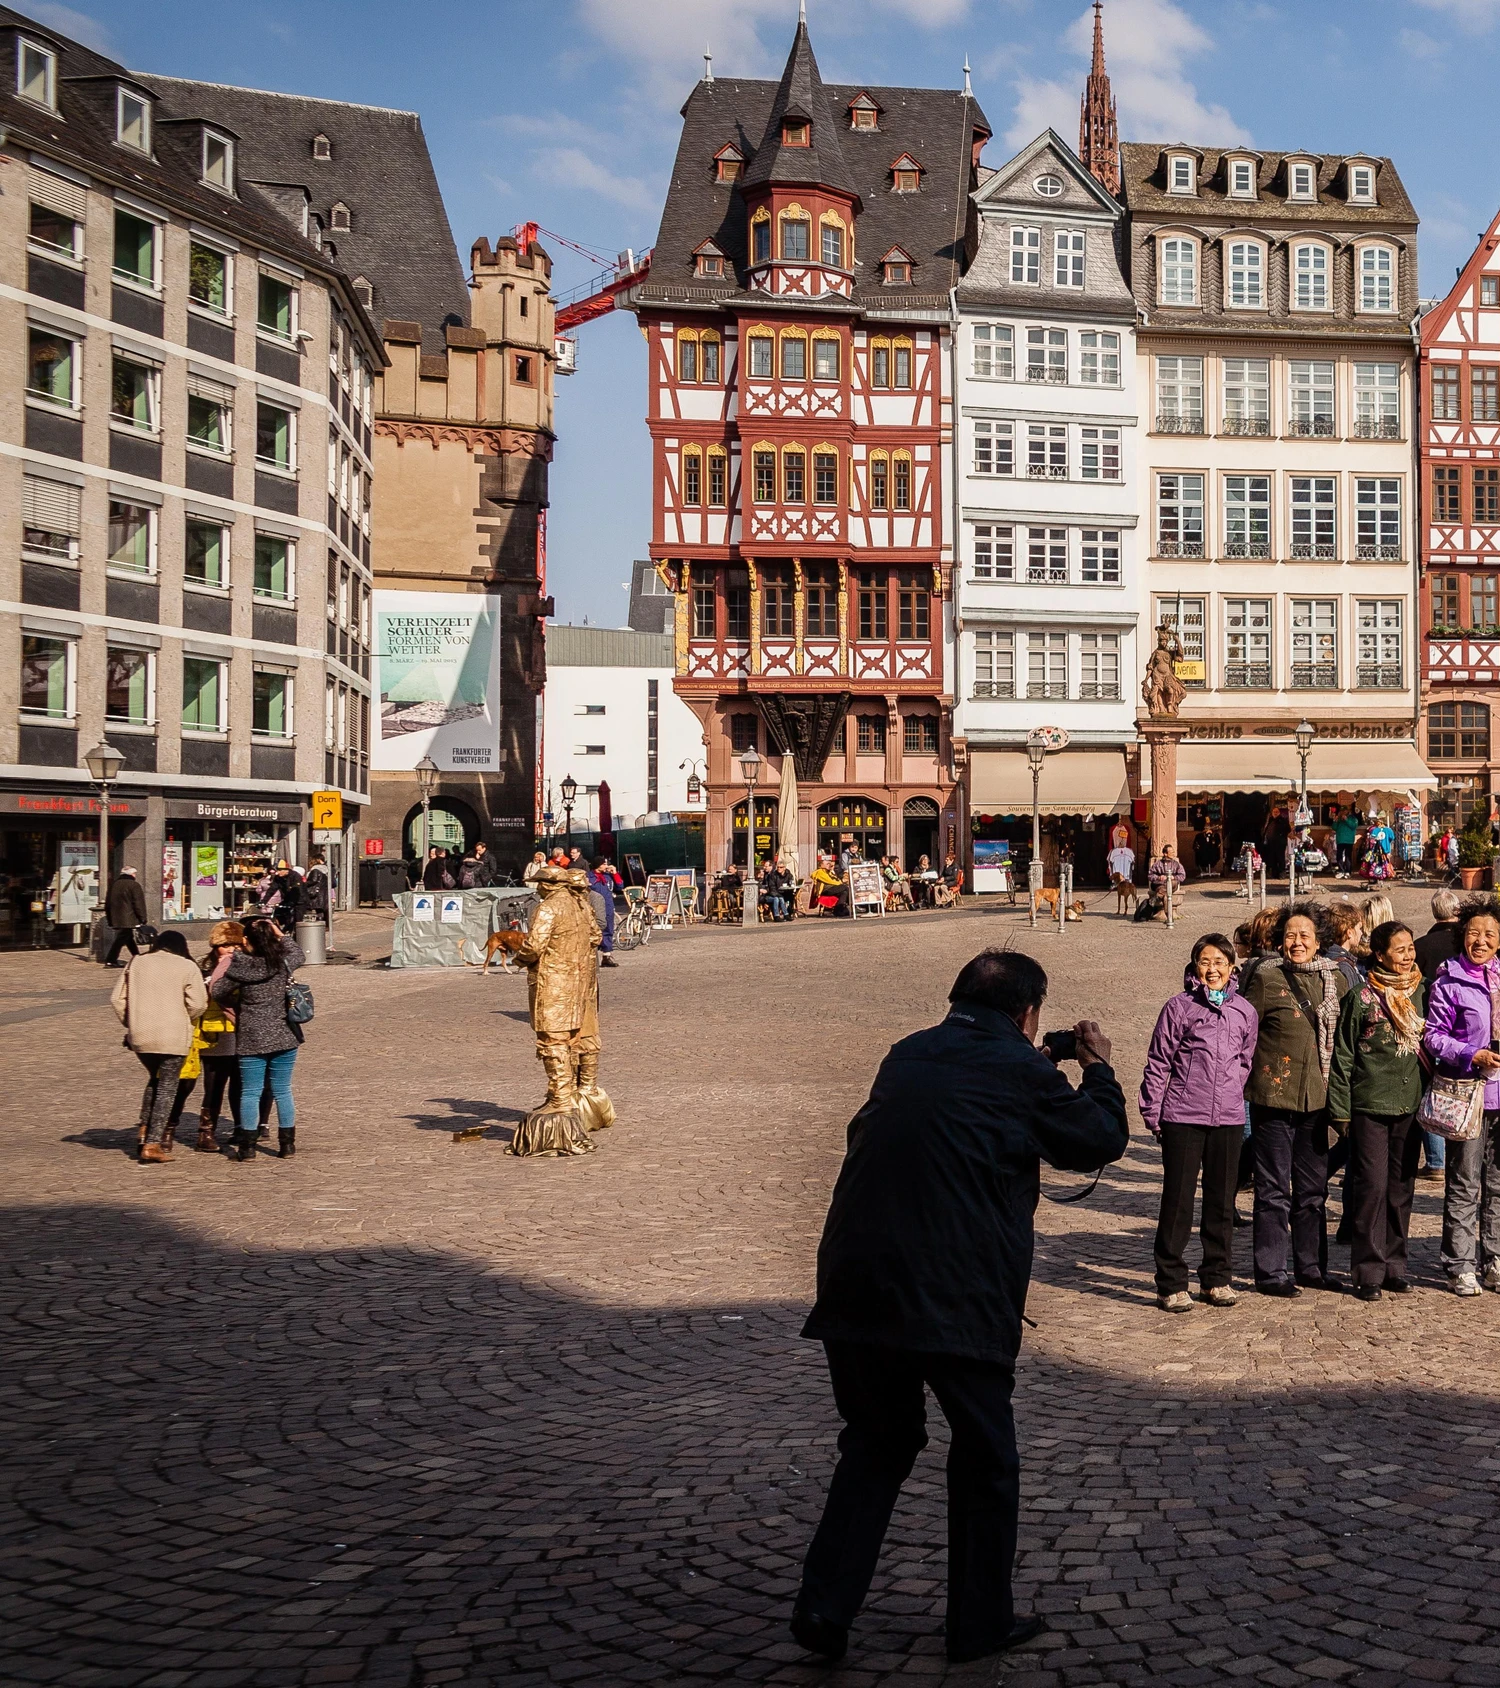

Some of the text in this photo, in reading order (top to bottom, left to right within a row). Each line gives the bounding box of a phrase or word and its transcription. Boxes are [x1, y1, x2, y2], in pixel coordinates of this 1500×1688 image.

[387, 617, 472, 627] VEREINZELT
[387, 627, 452, 636] SCHAUER
[388, 636, 470, 646] FORMEN VON
[388, 646, 441, 655] WETTER
[453, 748, 491, 756] FRANKFURTER
[453, 756, 490, 764] KUNSTVEREIN
[317, 795, 337, 803] Dom
[18, 796, 130, 813] Frankfurt Foum
[198, 804, 278, 820] Bürgerberatung
[820, 816, 884, 827] CHANGE
